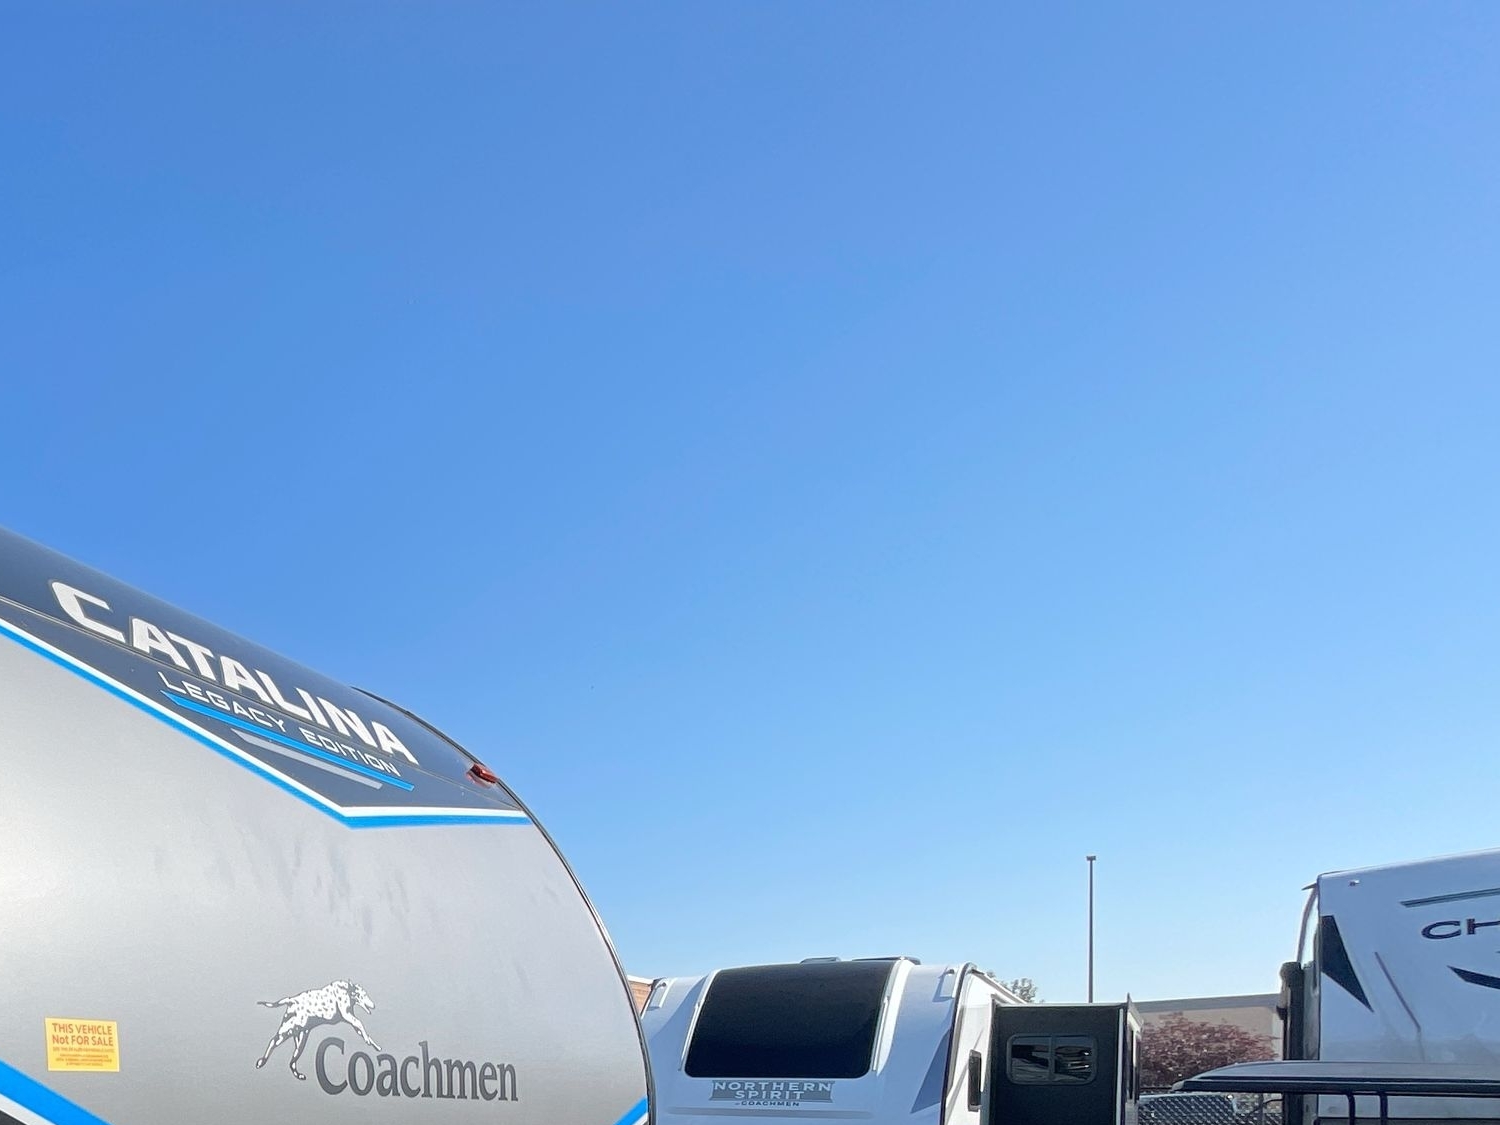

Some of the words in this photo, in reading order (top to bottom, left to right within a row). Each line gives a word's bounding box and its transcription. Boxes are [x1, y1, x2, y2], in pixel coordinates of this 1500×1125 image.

[51, 581, 419, 766] CATALINA
[158, 671, 287, 734] LEGACY
[299, 726, 401, 777] EDITION
[52, 1023, 74, 1034] THIS
[75, 1024, 113, 1036] VEHICLE
[71, 1035, 90, 1046] FOR
[91, 1036, 114, 1047] SALE
[315, 1036, 518, 1102] Coachmen
[714, 1082, 831, 1091] NORTHERN
[734, 1090, 805, 1100] SPIRIT
